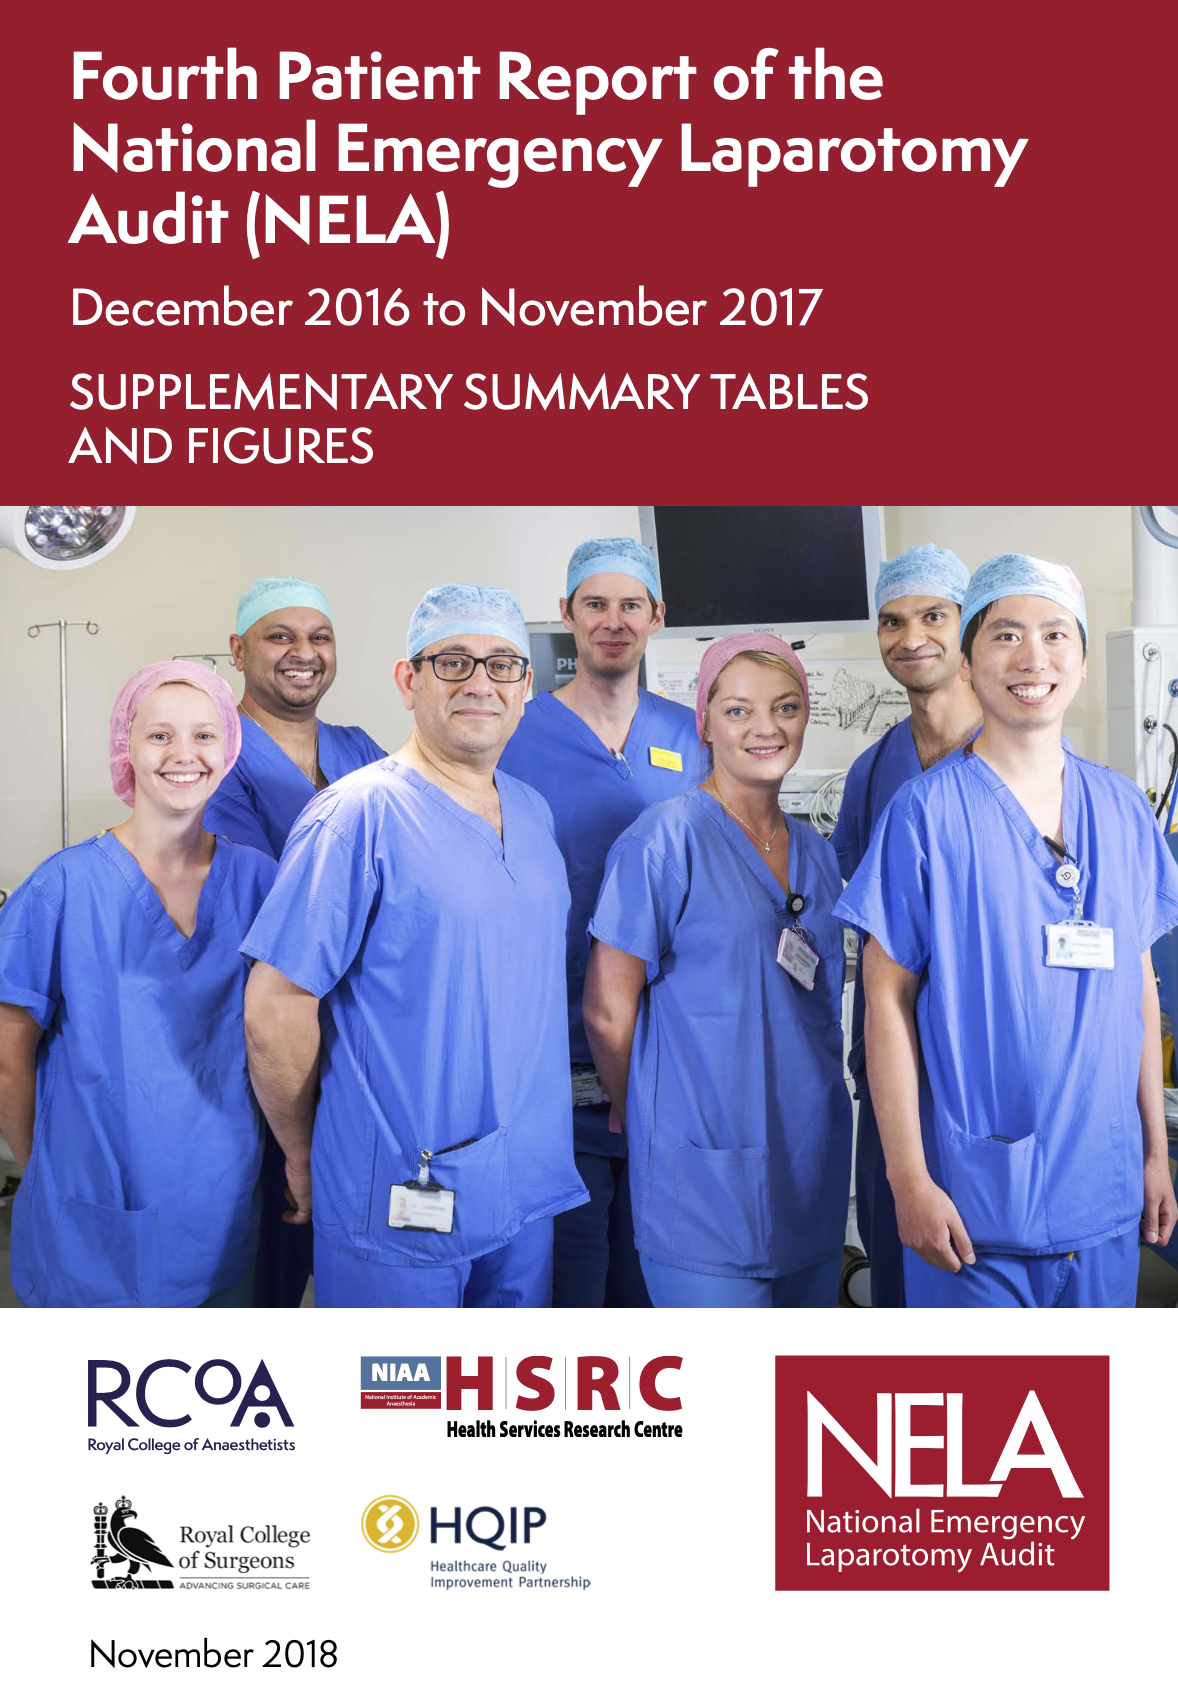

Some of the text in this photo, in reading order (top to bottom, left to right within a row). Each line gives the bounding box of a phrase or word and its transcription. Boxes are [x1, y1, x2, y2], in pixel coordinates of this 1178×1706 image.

[73, 47, 883, 115] Fourth Patient Report of the
[73, 119, 1029, 188] National Emergency Laparotomy
[68, 190, 449, 259] Audit (NELA)
[73, 285, 823, 326] December 2016 to November 2017
[70, 373, 868, 410] SUPPLEMENTARY SUMMARY TABLES
[68, 427, 373, 464] AND FIGURES
[372, 1363, 430, 1381] NIAA
[447, 1420, 683, 1437] Health Services Research Centre
[807, 1390, 1084, 1498] NELA
[88, 1438, 295, 1454] Royal College of Anaesthetists
[180, 1525, 310, 1546] Royal College
[431, 1506, 546, 1551] HQIP
[807, 1508, 1085, 1540] National Emergency
[179, 1551, 294, 1573] of Surgeons
[431, 1560, 547, 1574] Healthcare Quality
[807, 1541, 1055, 1573] Laparotomy Audit
[431, 1576, 591, 1590] Improvement Partnership
[91, 1638, 337, 1668] November 2018
